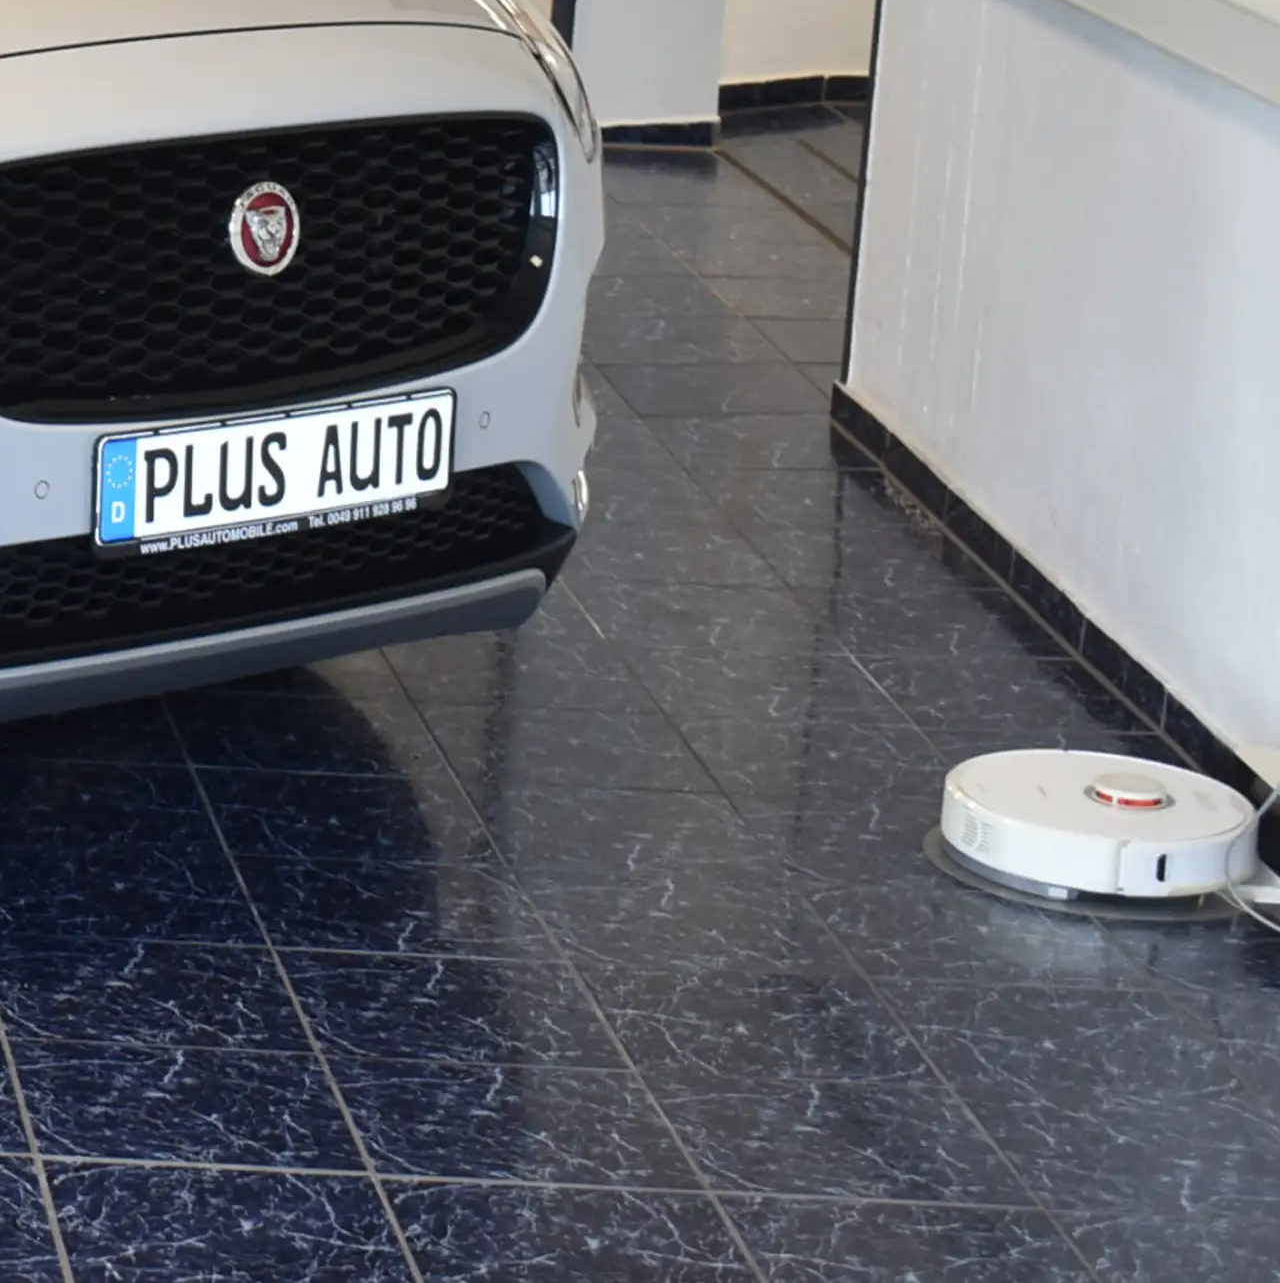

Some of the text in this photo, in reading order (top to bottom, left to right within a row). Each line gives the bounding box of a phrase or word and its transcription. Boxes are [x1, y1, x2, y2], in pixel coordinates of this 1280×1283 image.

[111, 408, 443, 524] D PLUS AUTO
[140, 520, 299, 555] www.PLUSAUTOMOBILE.com
